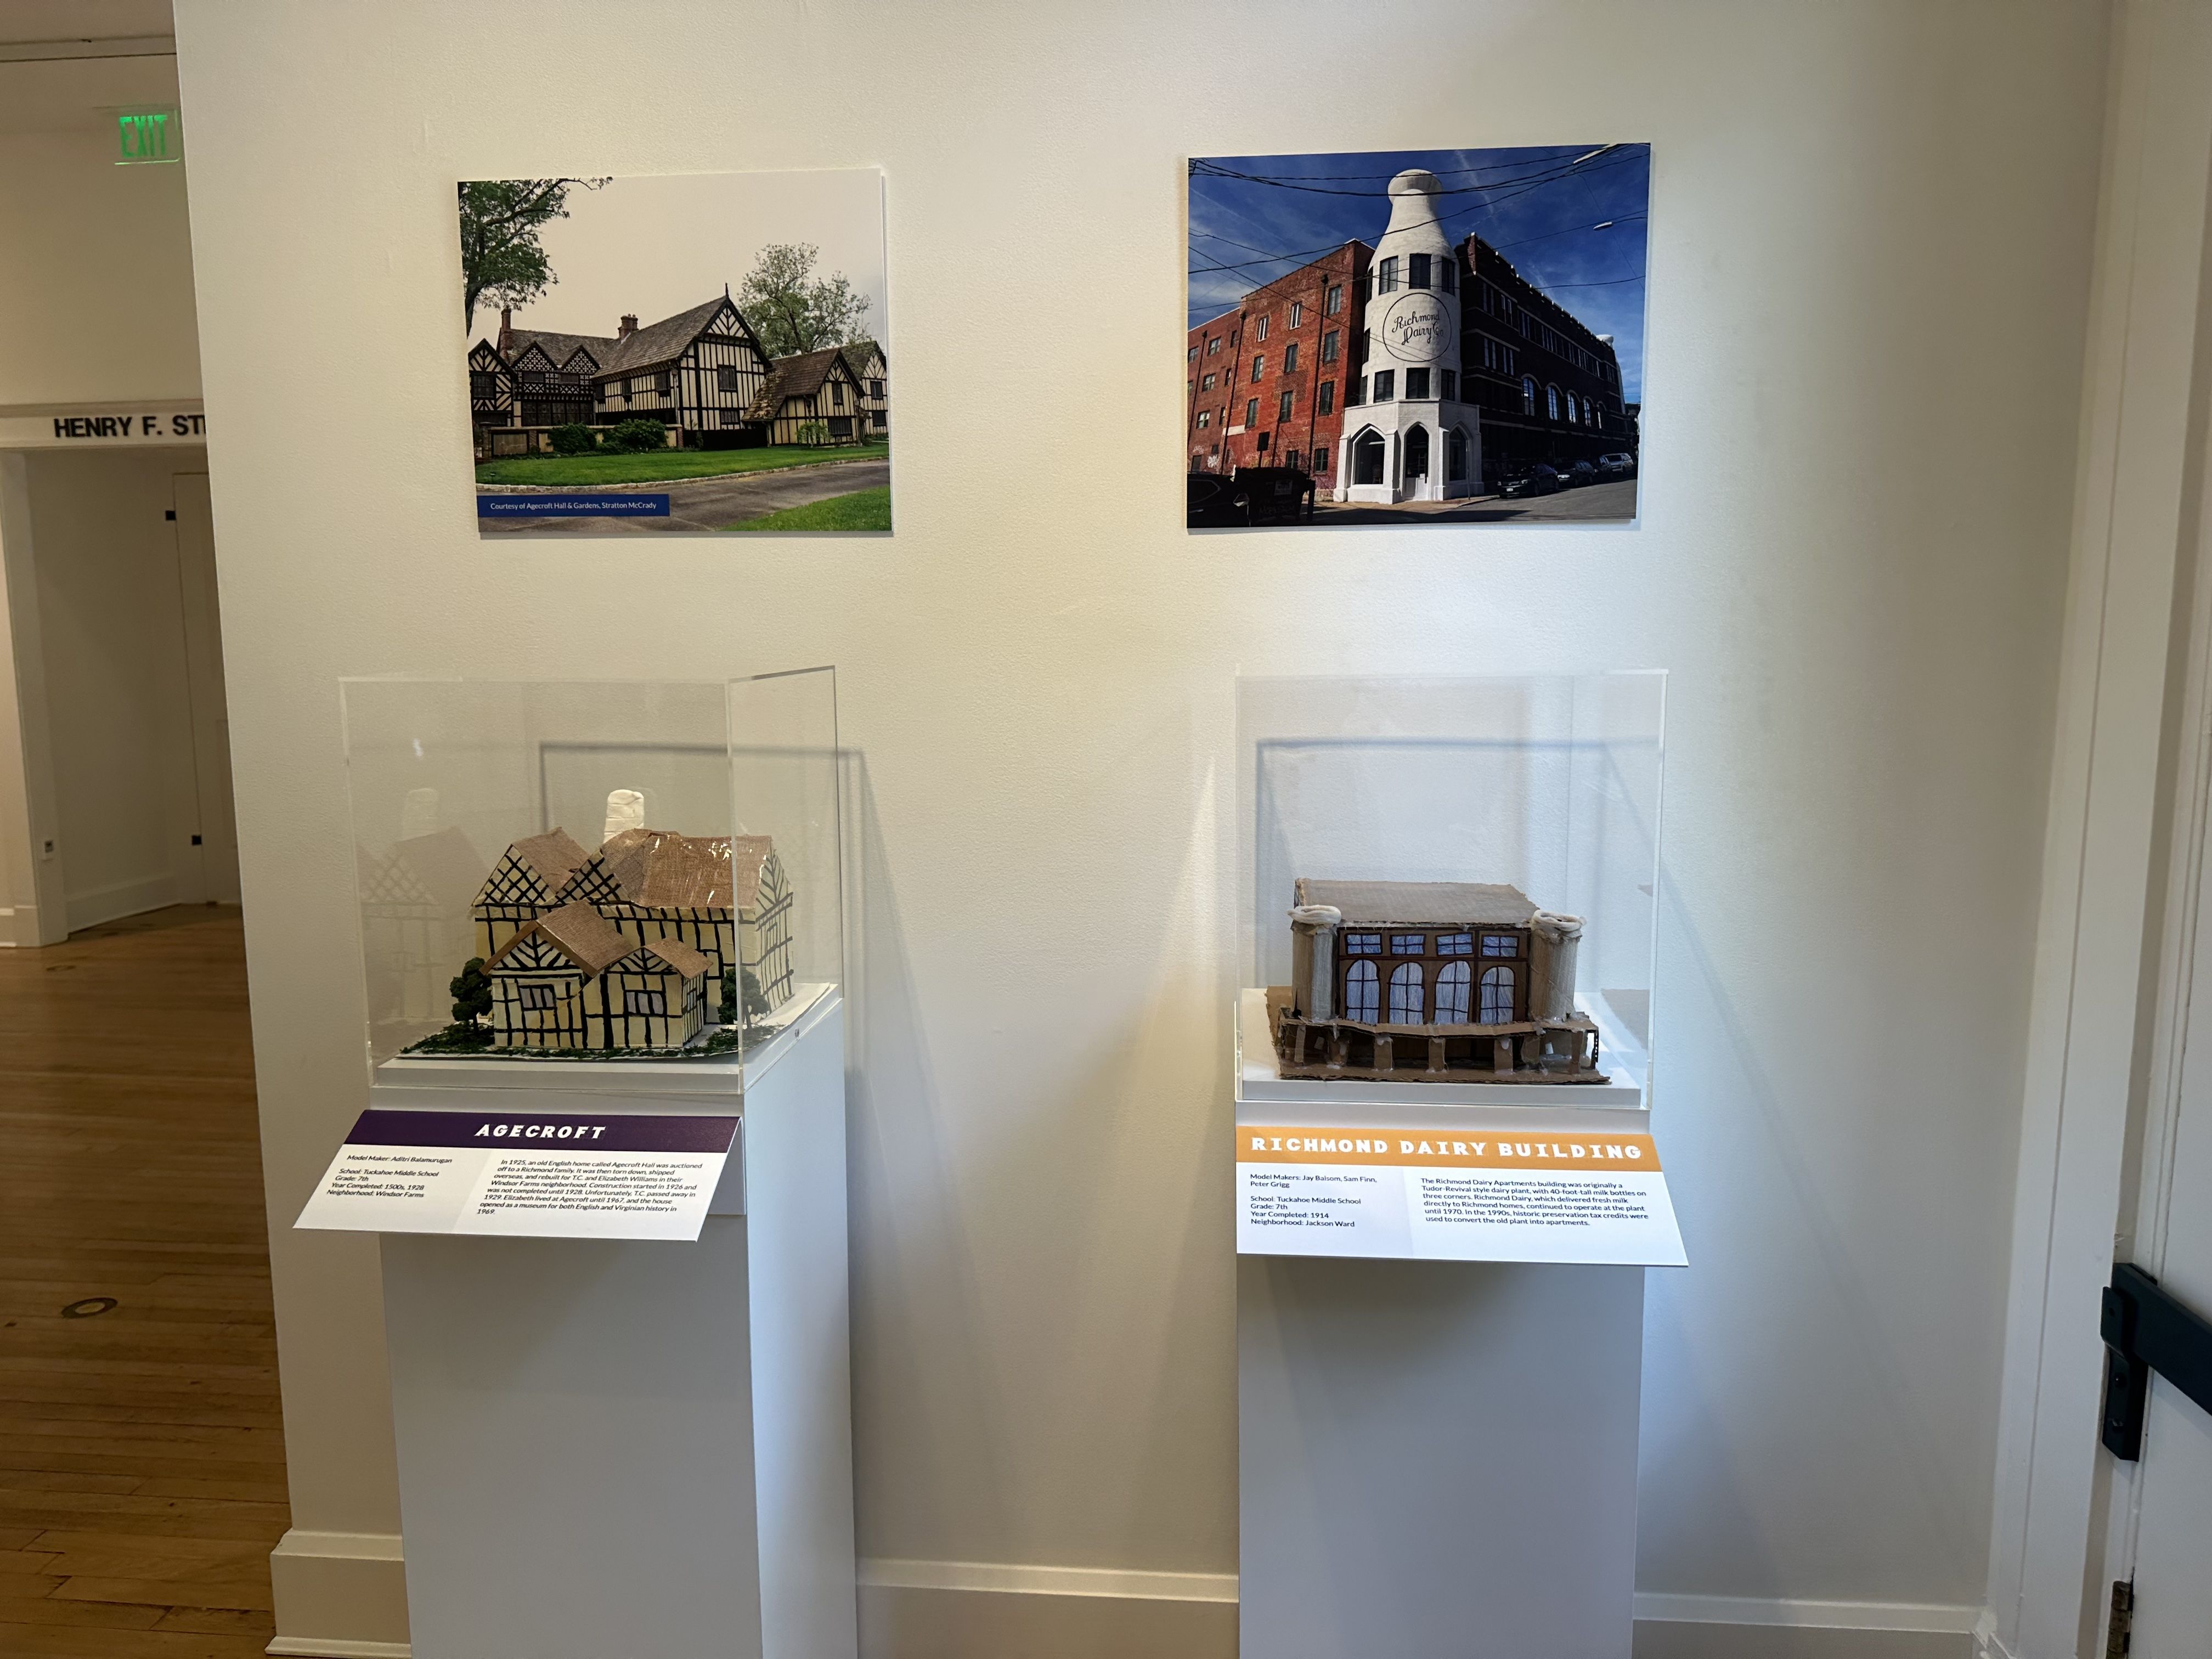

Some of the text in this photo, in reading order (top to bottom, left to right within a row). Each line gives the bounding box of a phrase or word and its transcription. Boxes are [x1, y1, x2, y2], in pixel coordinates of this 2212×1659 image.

[119, 114, 167, 158] EXIT
[1391, 311, 1441, 333] Richmond
[1401, 326, 1432, 346] Dairy
[54, 416, 132, 438] HENRY
[142, 416, 162, 436] F.
[526, 502, 553, 511] Agecroft
[573, 501, 601, 510] Gardens,
[628, 501, 657, 510] McCrady
[474, 1124, 606, 1138] AGECROFT
[1251, 1137, 1641, 1159] RICHMOND DAIRY BUILDING
